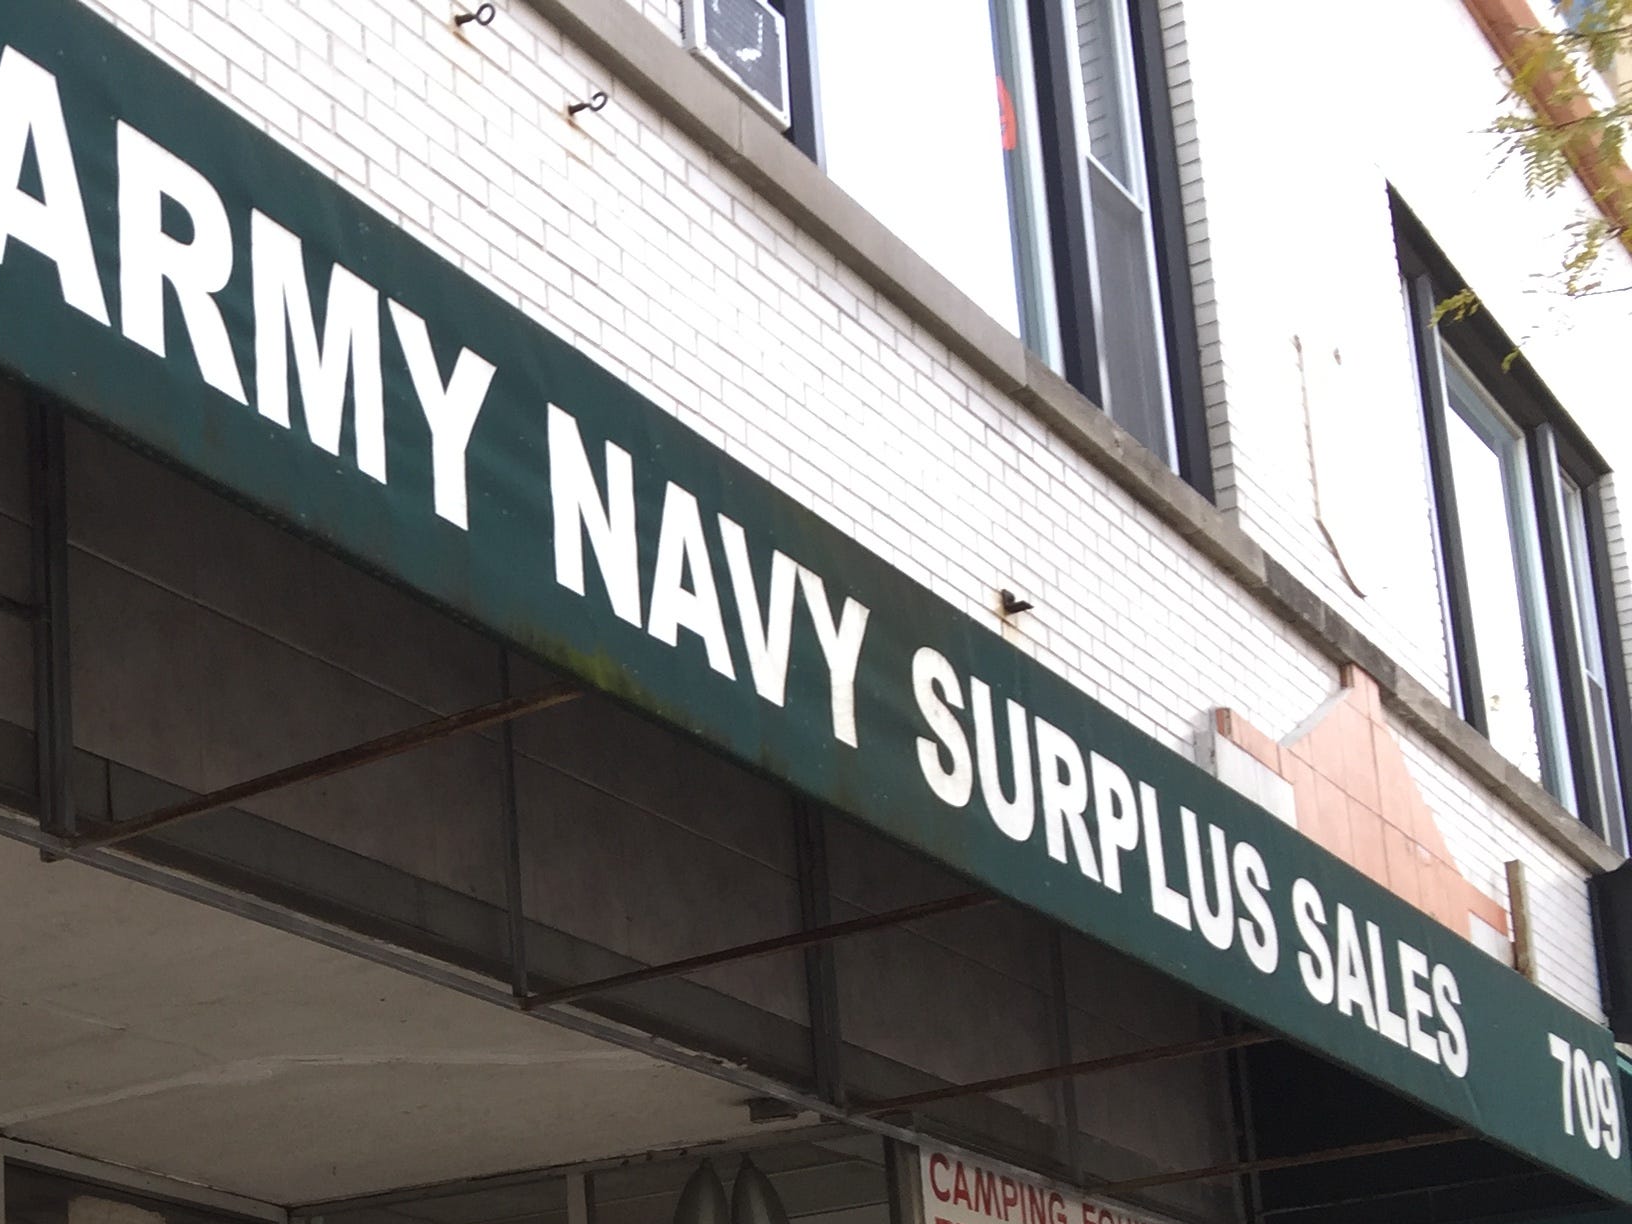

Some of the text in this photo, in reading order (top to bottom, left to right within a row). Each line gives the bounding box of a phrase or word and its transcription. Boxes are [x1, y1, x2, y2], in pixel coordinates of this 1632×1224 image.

[548, 402, 870, 748] NAVY
[913, 648, 1279, 974] SURPLUS
[1292, 878, 1468, 1078] SALES
[1548, 1033, 1621, 1159] 709
